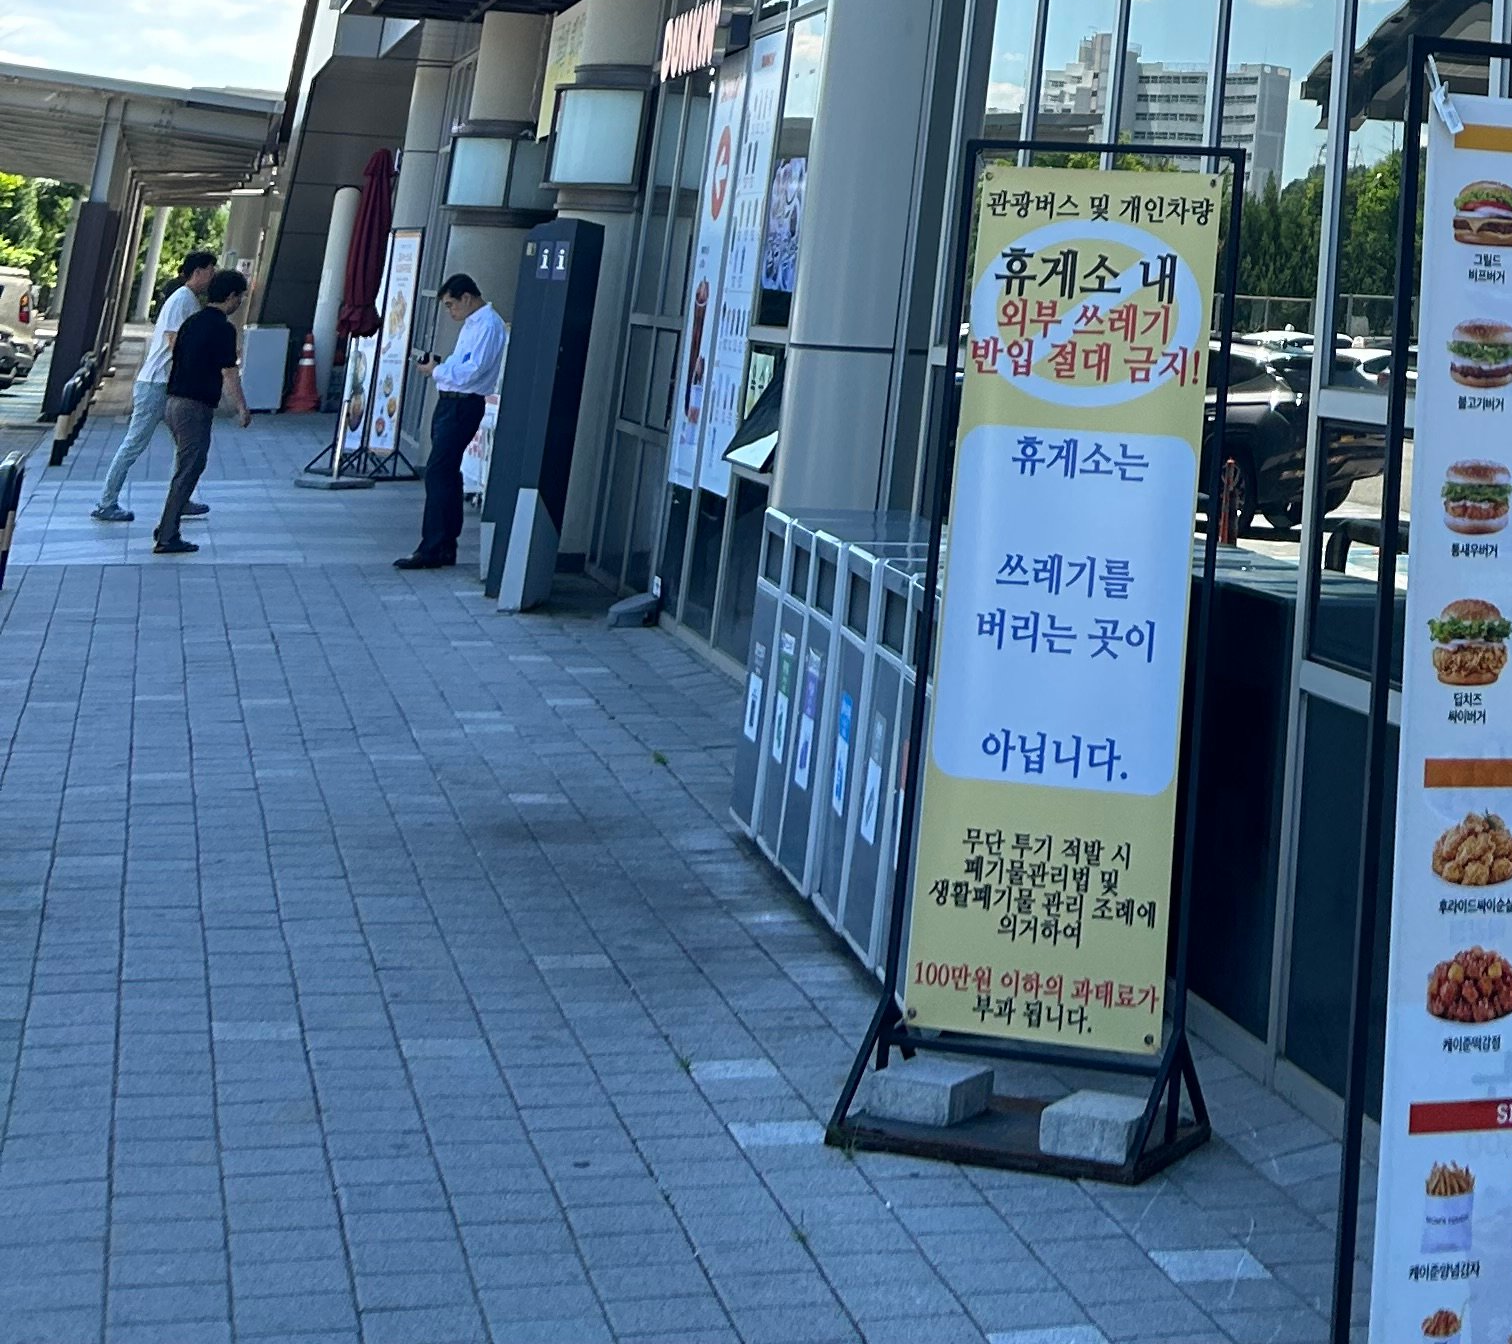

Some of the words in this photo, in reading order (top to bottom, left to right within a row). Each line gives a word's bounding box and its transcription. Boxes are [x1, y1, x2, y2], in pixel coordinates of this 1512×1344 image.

[987, 190, 1081, 220] 관광버스
[1088, 194, 1110, 222] 및
[1119, 195, 1214, 226] 개인차량
[994, 247, 1122, 300] 휴게소
[1140, 252, 1178, 305] 내
[1469, 268, 1505, 284] 비프버거
[997, 298, 1062, 334] 외부
[1072, 302, 1171, 345] 쓰레기
[971, 337, 1033, 378] 반입
[1048, 341, 1110, 384] 절대
[1123, 344, 1201, 388] 금지!
[1458, 395, 1504, 412] 불고기버거
[1011, 435, 1150, 483] 휴게소는
[995, 552, 1135, 601] 쓰레기를
[977, 607, 1078, 654] 버리는
[1087, 618, 1157, 664] 곳이
[1448, 709, 1486, 724] 싸이버거
[1453, 692, 1482, 706] 딥치즈
[981, 728, 1129, 783] 아닙니다.
[961, 828, 1006, 856] 무단
[1011, 832, 1053, 861] 투기
[1060, 837, 1104, 865] 적발
[1112, 841, 1132, 869] 시
[964, 857, 1092, 895] 폐기물관리법
[1100, 869, 1120, 897] 및
[928, 879, 1036, 916] 생활폐기물
[1044, 890, 1085, 920] 관리
[1092, 898, 1158, 929] 조례에
[997, 916, 1083, 949] 의거하여
[914, 961, 993, 993] 100만원
[1000, 970, 1064, 1003] 이하의
[1071, 978, 1160, 1014] 과태료가
[972, 994, 1016, 1025] 부과
[1023, 1000, 1093, 1036] 됩니다.
